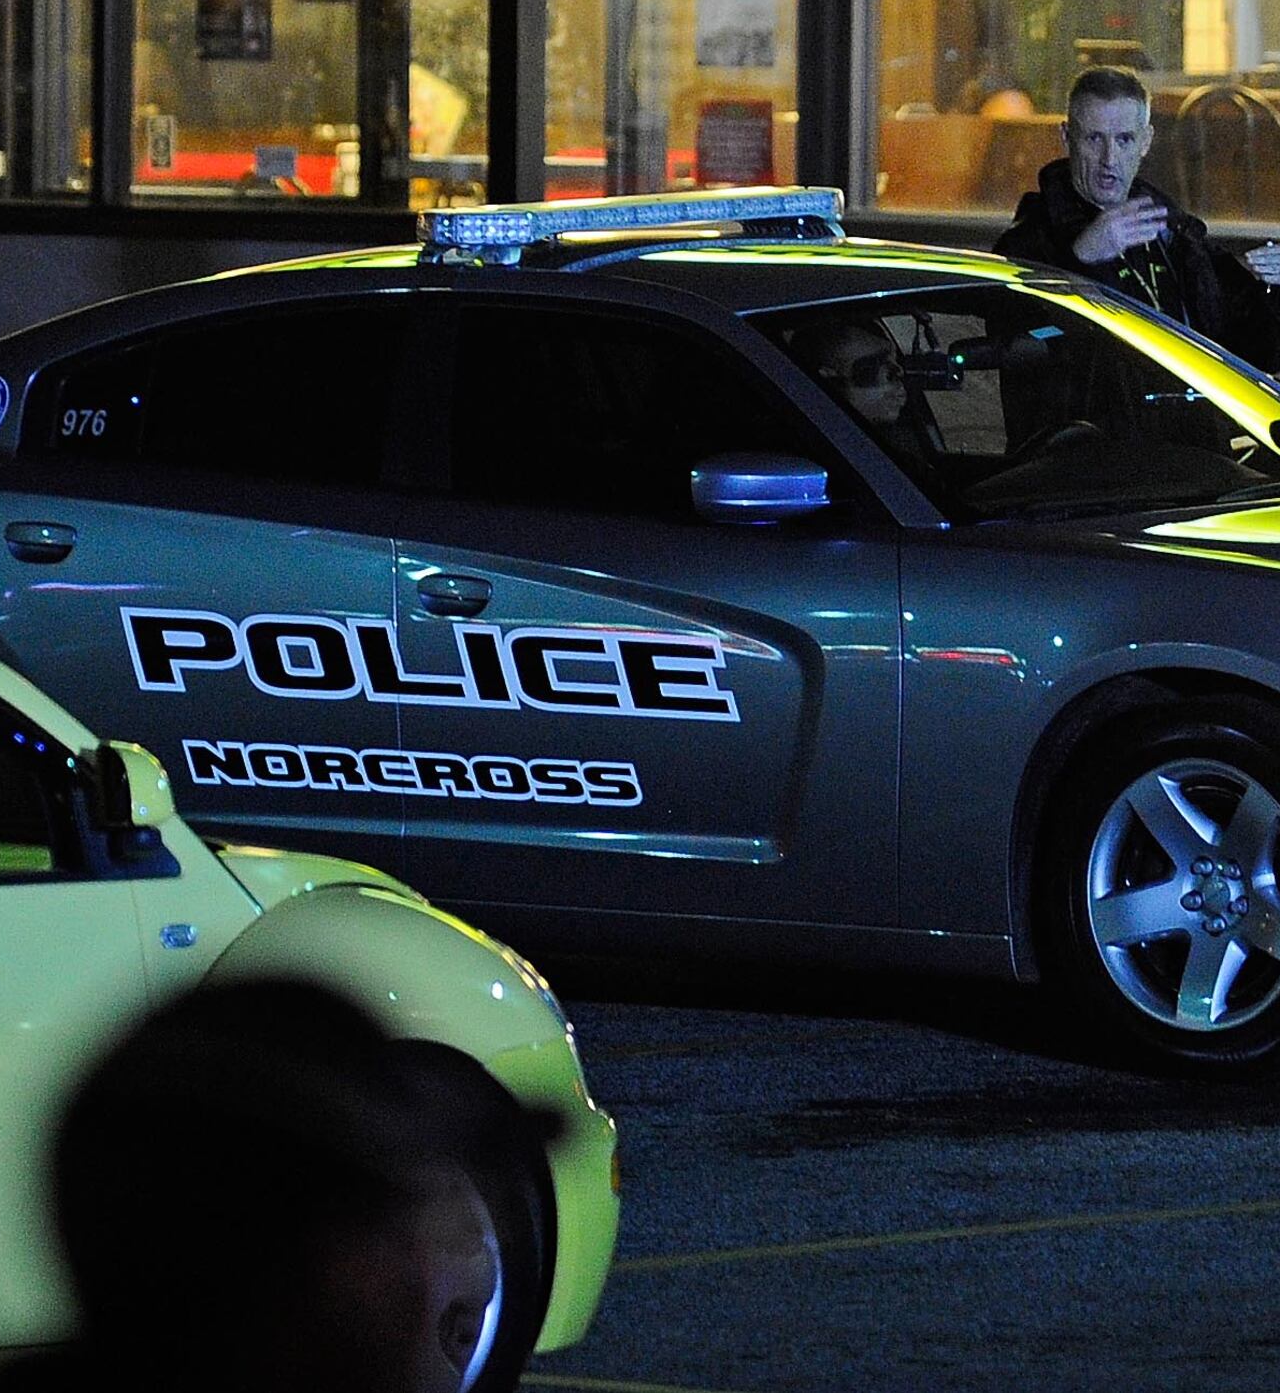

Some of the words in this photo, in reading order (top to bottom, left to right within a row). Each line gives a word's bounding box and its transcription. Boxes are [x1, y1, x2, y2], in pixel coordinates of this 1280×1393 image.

[61, 409, 107, 436] 976
[120, 606, 740, 722] POLICE
[181, 739, 642, 806] NORCROSS
